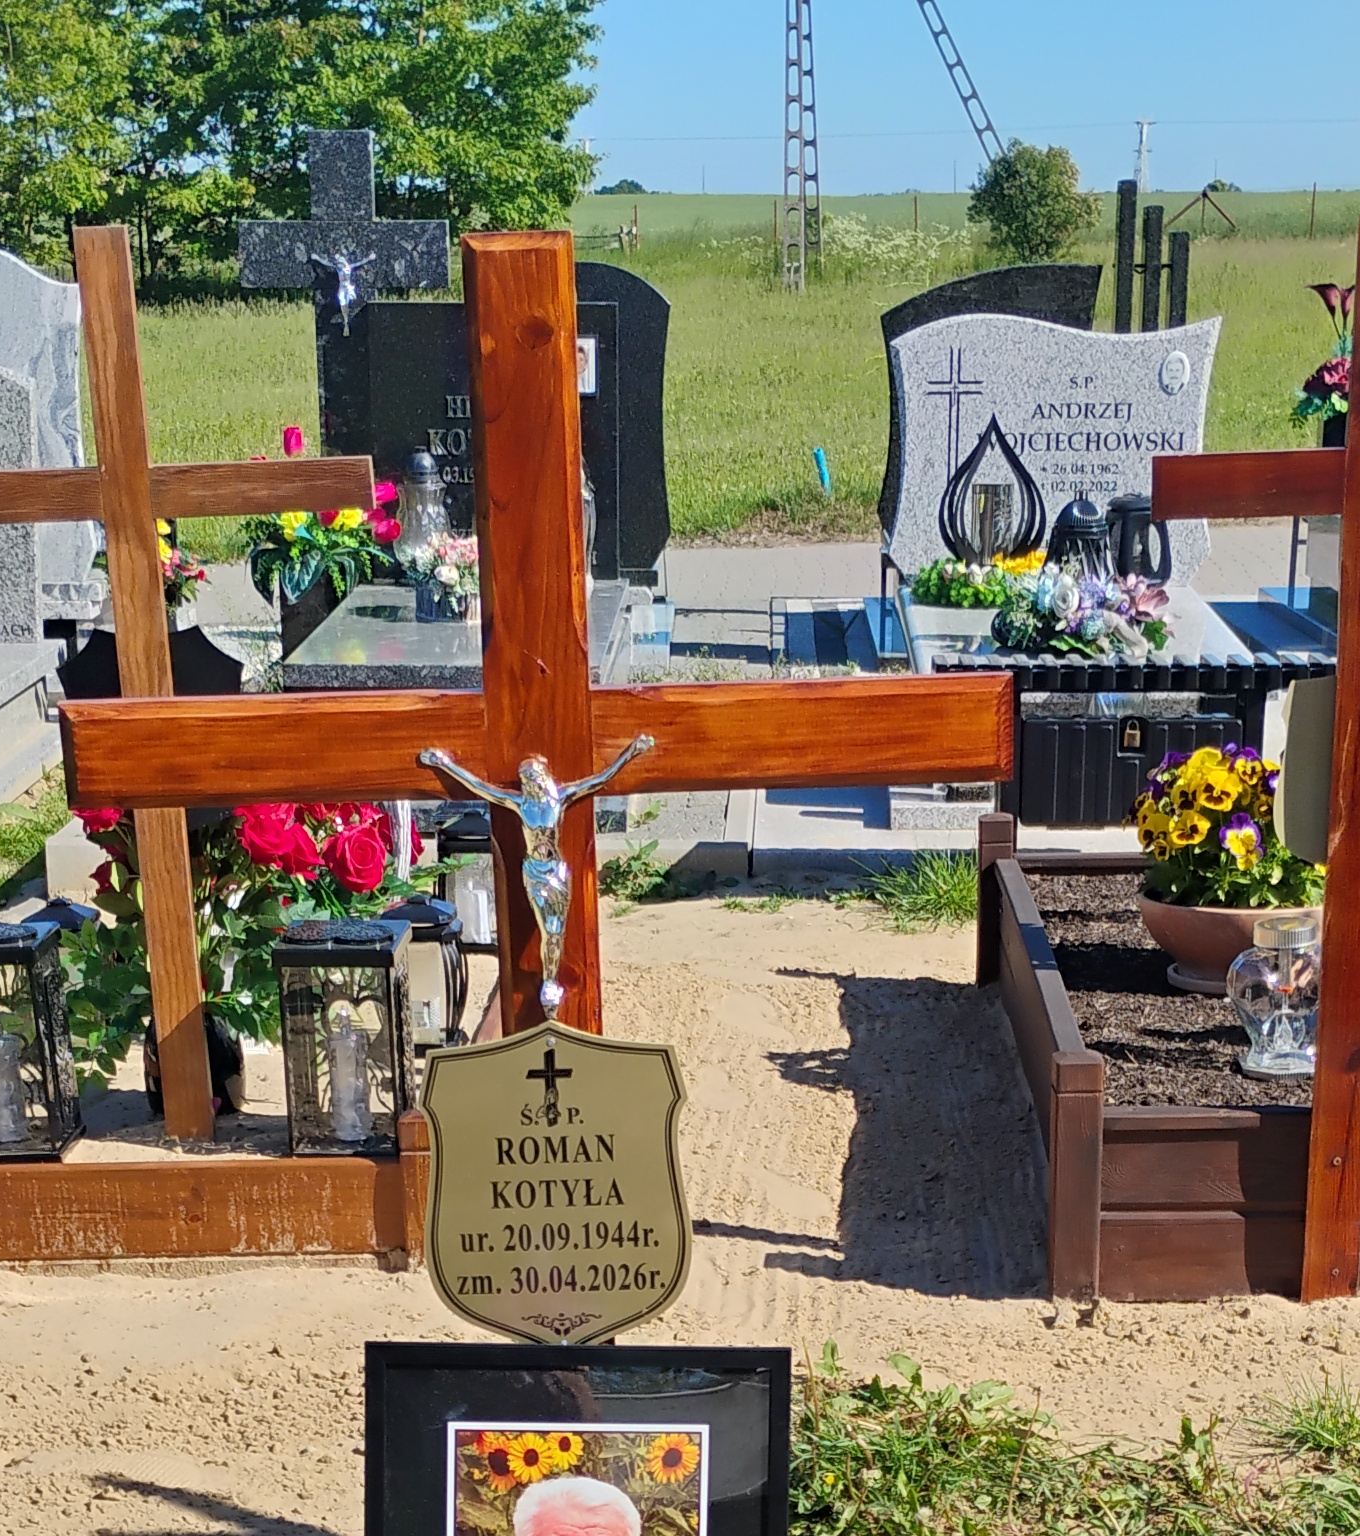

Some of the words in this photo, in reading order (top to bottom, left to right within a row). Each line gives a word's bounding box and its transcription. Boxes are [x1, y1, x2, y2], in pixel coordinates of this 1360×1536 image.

[1031, 402, 1133, 423] ANDRZEJ
[1052, 463, 1119, 475] 26.04.1962
[1051, 481, 1118, 492] 02.02.2022
[566, 1107, 585, 1125] P.
[495, 1134, 616, 1165] ROMAN
[490, 1177, 626, 1210] KOTYŁA
[460, 1231, 495, 1253] ur.
[502, 1220, 660, 1252] 20.09.1944r.
[457, 1274, 502, 1295] zm.
[510, 1262, 667, 1295] 30.04.2026r.
